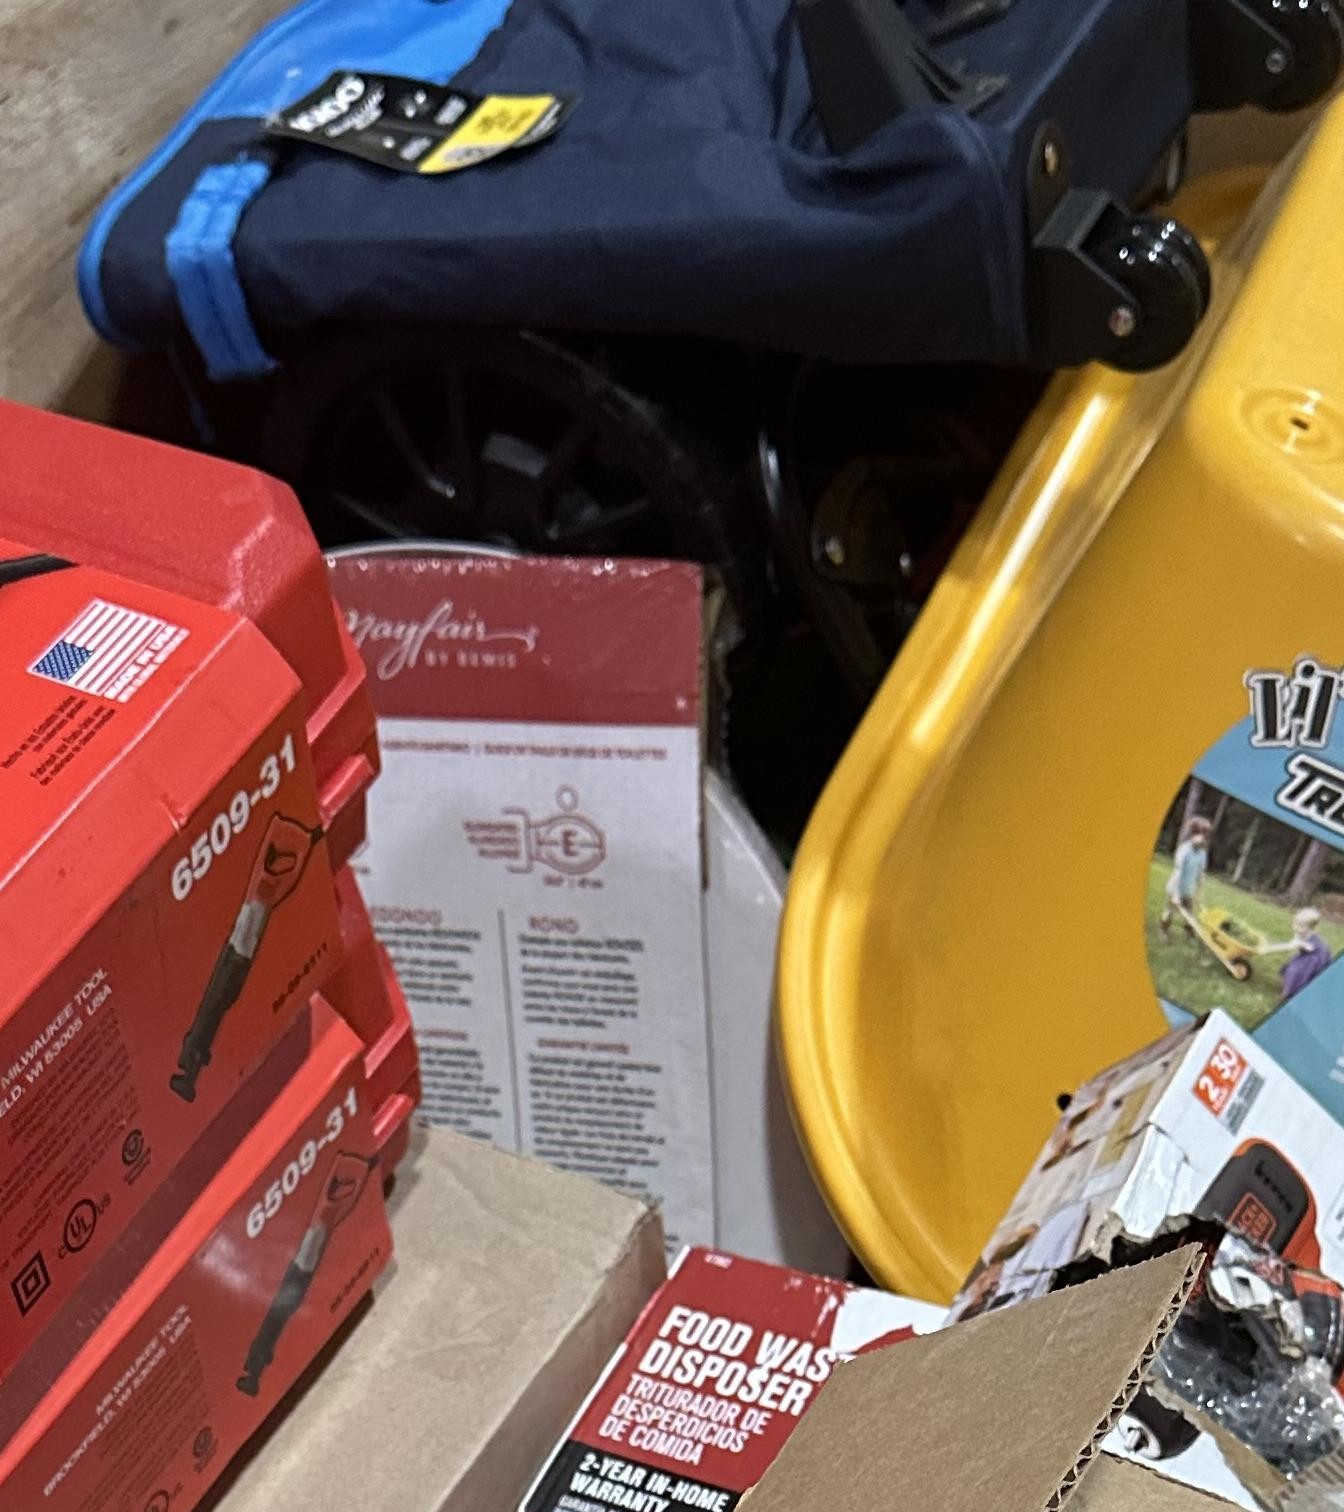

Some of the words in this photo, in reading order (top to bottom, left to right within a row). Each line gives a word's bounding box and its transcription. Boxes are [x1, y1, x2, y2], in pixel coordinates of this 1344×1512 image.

[170, 733, 296, 901] 6509-31
[0, 1001, 74, 1090] MILWAUKEE
[73, 967, 109, 1006] TOOL
[246, 1086, 359, 1240] 6509-31
[658, 1304, 753, 1363] FOOD
[626, 1374, 742, 1428] TRITURADOR
[741, 1408, 772, 1435] DE
[637, 1342, 814, 1417] DISPOSER
[598, 1415, 627, 1442] DE
[628, 1424, 704, 1466] COMIDA
[610, 1395, 749, 1454] DESPERDICIOS
[576, 1451, 645, 1488] 2-YEAR
